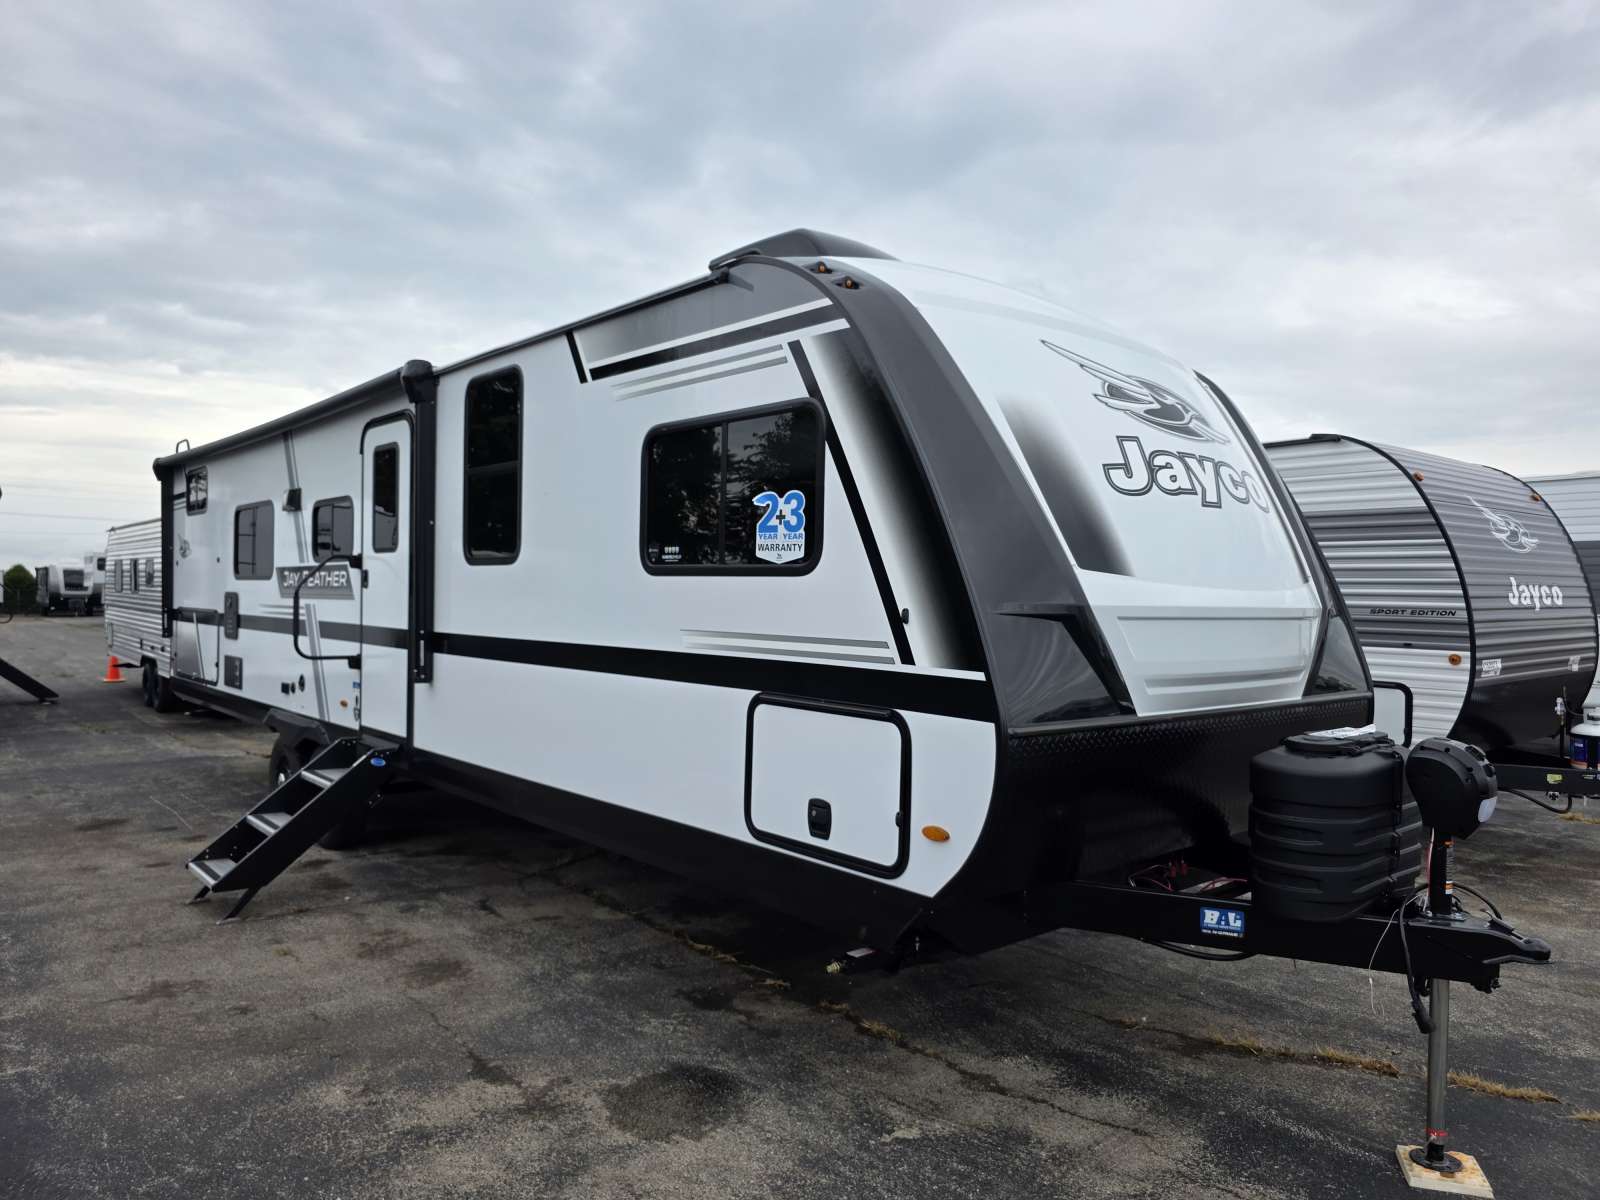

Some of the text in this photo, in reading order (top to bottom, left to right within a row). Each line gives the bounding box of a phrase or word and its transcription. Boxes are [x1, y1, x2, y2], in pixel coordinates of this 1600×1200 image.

[1102, 435, 1270, 514] Jayco
[757, 543, 803, 552] WARRANTY
[283, 571, 300, 586] JAY
[1508, 576, 1563, 611] Jayco
[1369, 607, 1457, 617] SPORT EDITION
